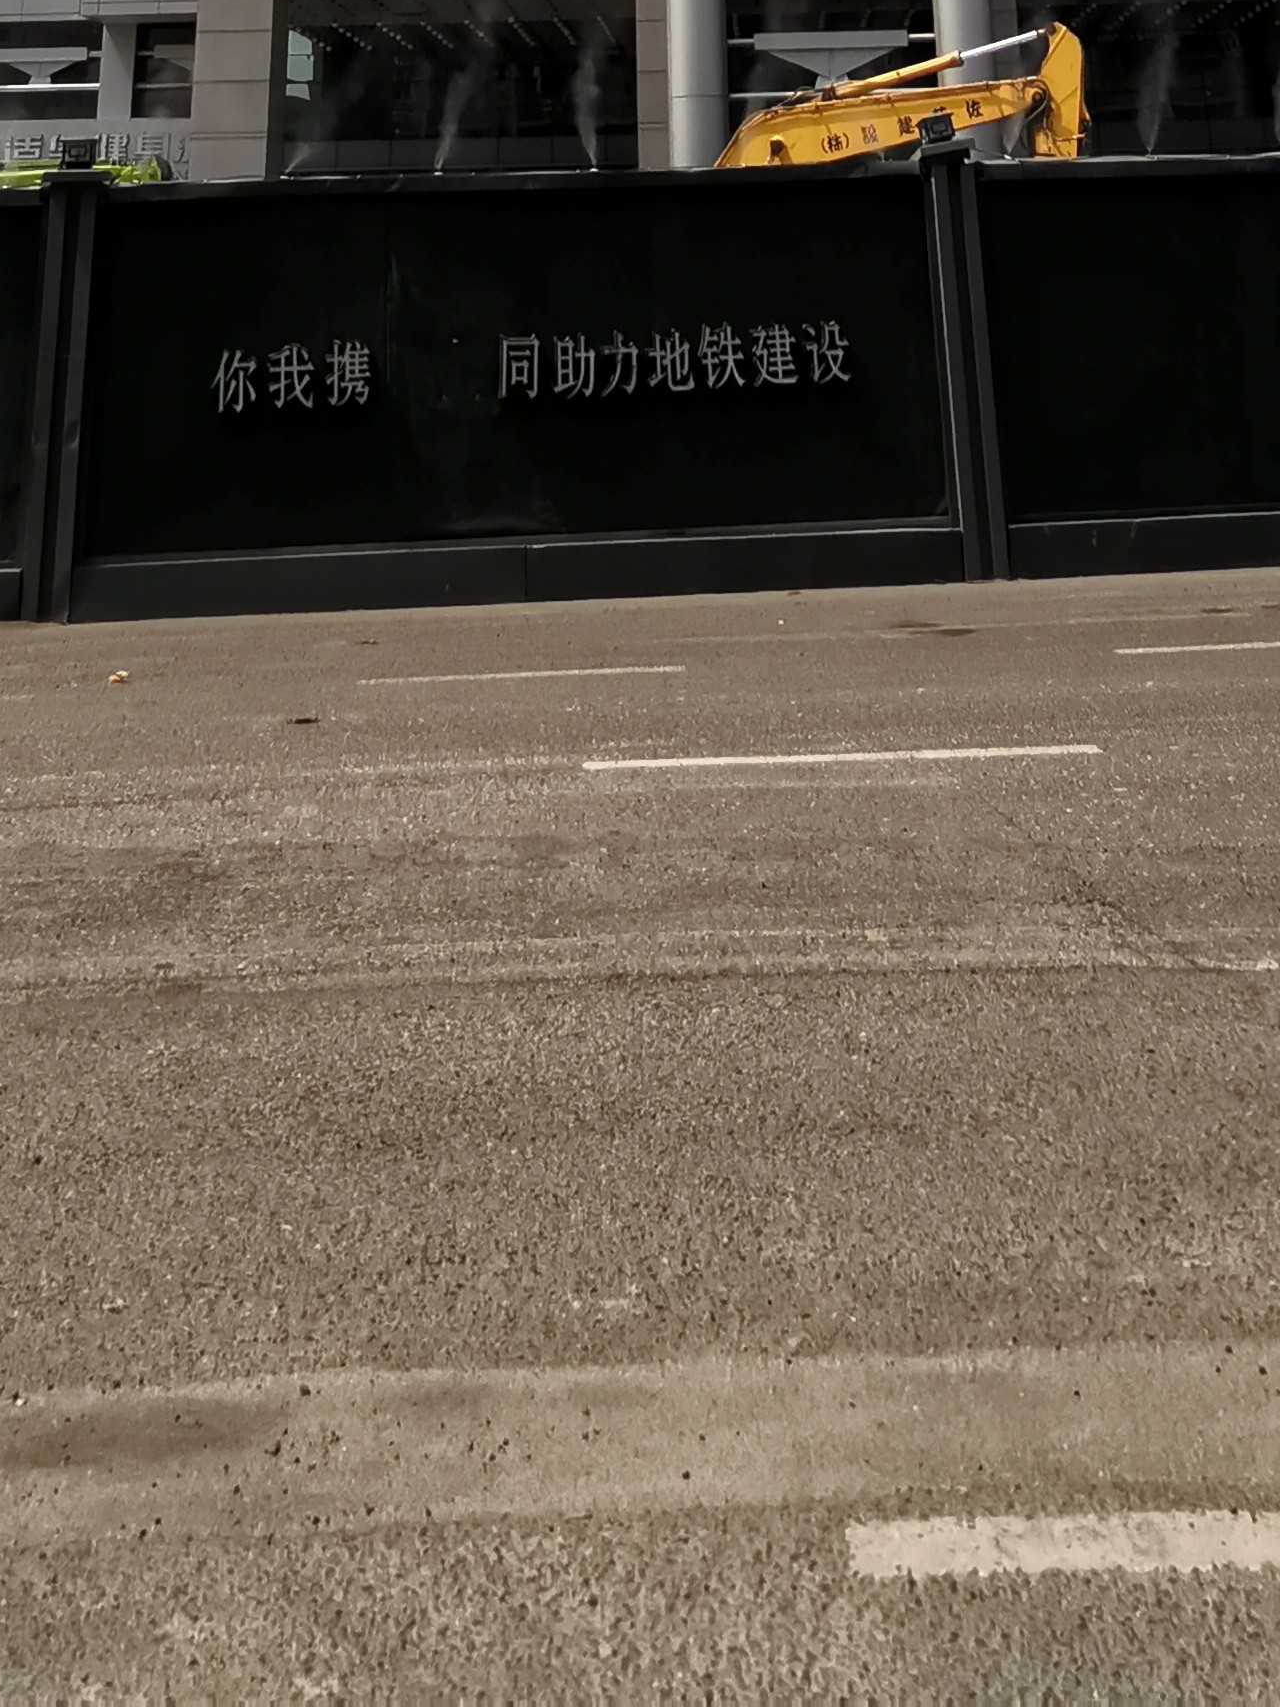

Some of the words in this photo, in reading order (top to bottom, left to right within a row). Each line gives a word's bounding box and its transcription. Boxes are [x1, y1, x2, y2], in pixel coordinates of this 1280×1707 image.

[212, 337, 372, 414] 你我携
[497, 320, 852, 401] 同助力地铁建设
